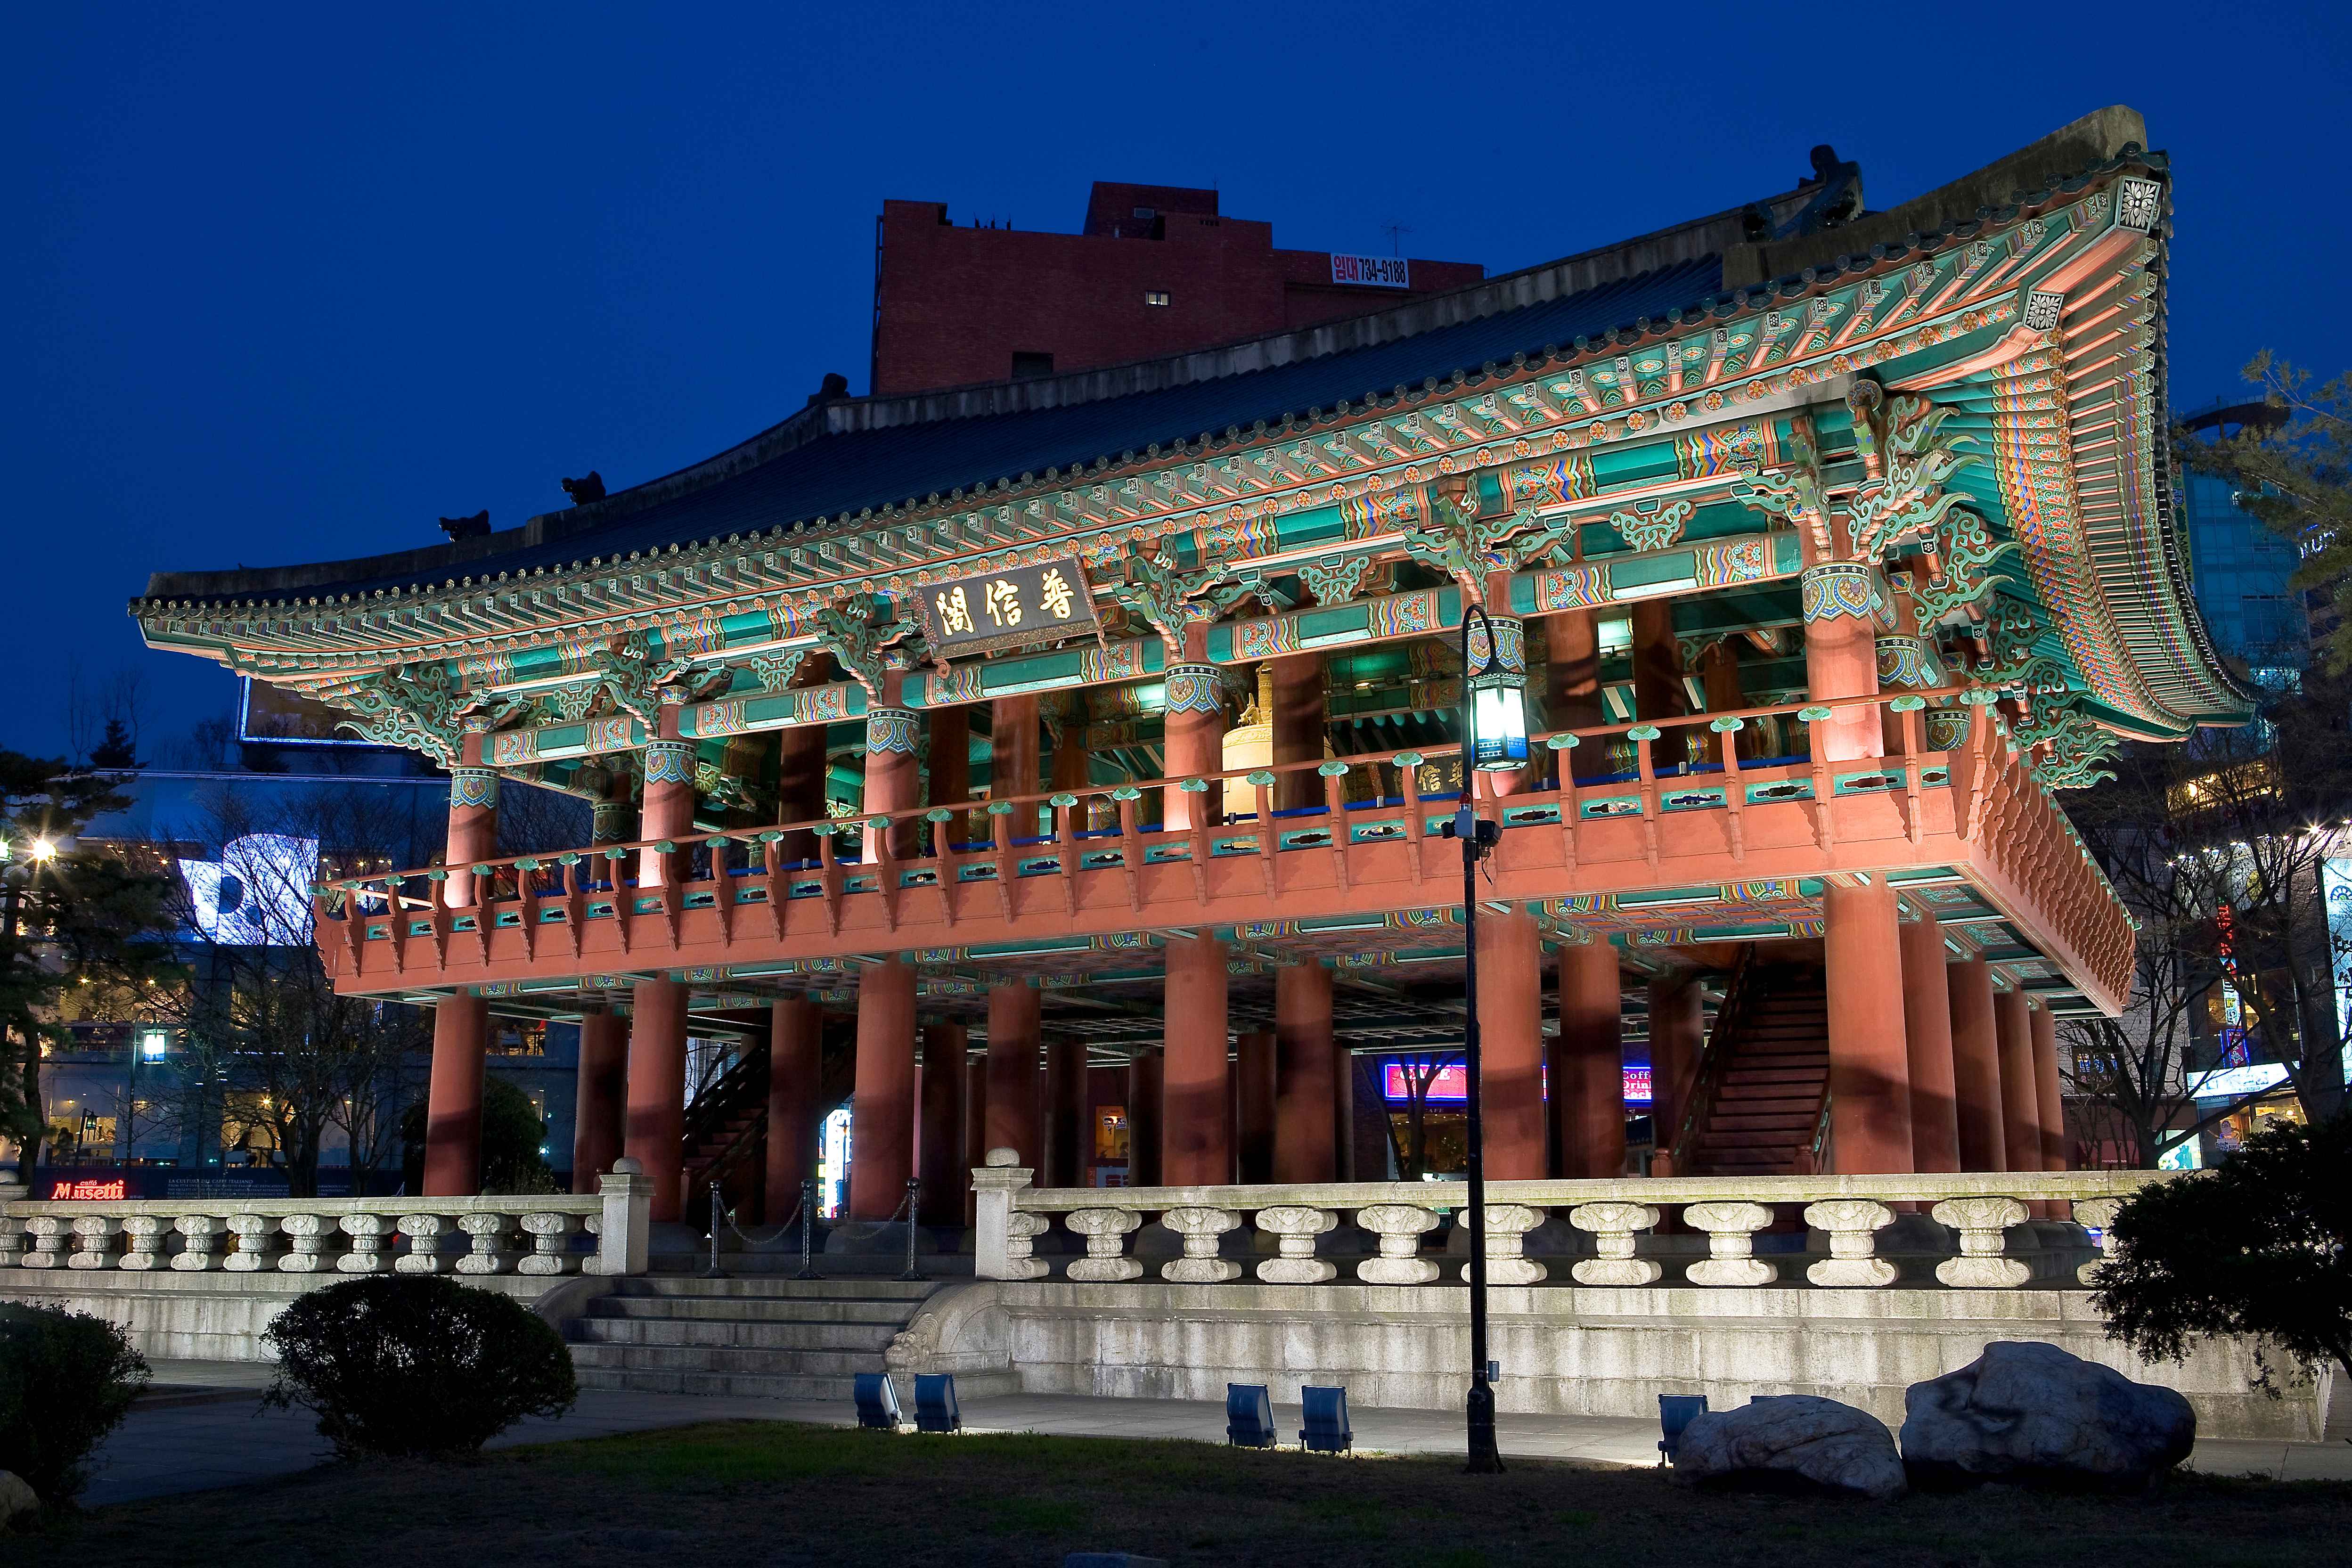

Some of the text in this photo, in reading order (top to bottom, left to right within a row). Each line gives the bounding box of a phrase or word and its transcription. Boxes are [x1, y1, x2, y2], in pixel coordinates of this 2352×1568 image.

[1333, 255, 1406, 283] 임대 734-9188
[51, 1180, 124, 1199] Musetti
